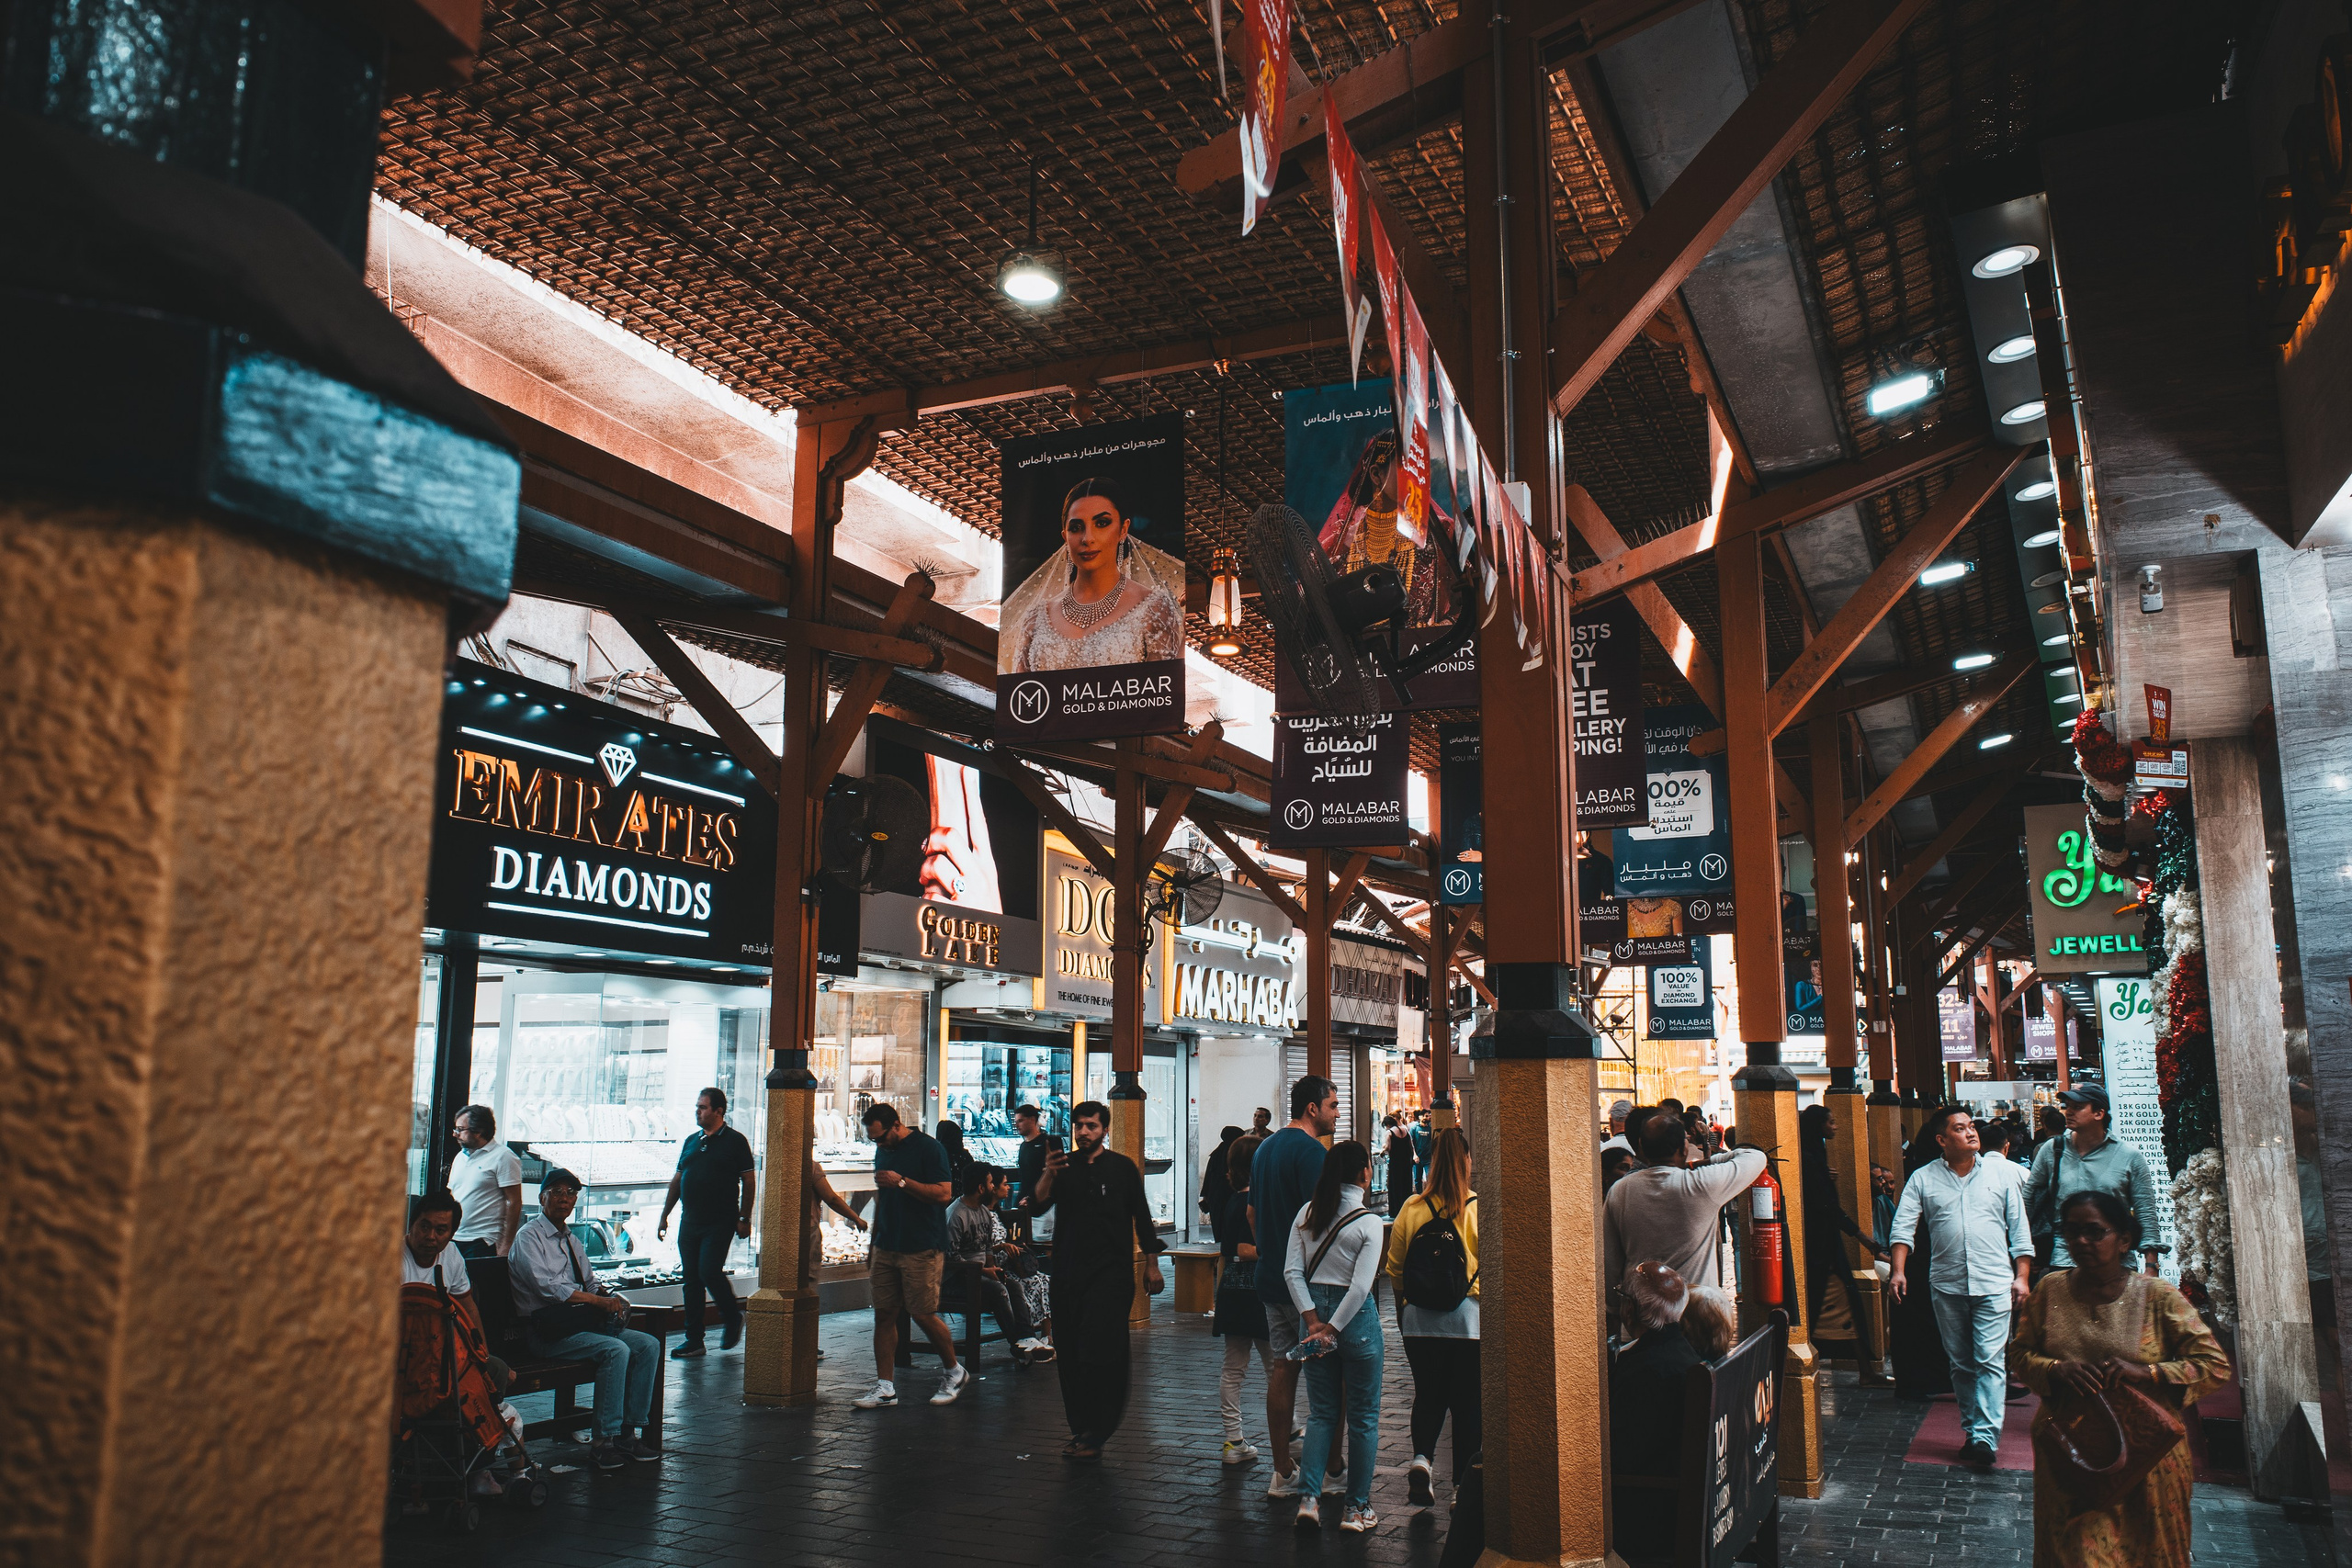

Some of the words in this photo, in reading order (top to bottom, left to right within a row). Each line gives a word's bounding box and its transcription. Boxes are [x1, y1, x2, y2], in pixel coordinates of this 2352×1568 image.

[1303, 410, 1341, 427] وألماس
[1343, 408, 1371, 422] ذهب
[1105, 445, 1119, 455] من
[1121, 437, 1166, 451] مجوهرات
[1018, 451, 1052, 468] وألماس
[1054, 450, 1078, 463] ذهب
[1080, 446, 1103, 459] ملبار
[1063, 676, 1172, 702] MALABAR
[1062, 702, 1096, 715] GOLD
[1098, 702, 1106, 712] &
[1108, 695, 1172, 711] DIAMONDS
[2152, 698, 2165, 711] WIN
[1655, 726, 1685, 739] الوقت
[1304, 734, 1377, 754] المضافة
[1658, 742, 1678, 755] في
[1647, 778, 1702, 799] 00%
[449, 749, 743, 873] EMIRATES
[1322, 801, 1400, 816] MALABAR
[1584, 804, 1636, 815] DIAMONDS
[1322, 816, 1346, 825] GOLD
[1347, 816, 1353, 824] &
[1354, 815, 1400, 824] DIAMONDS
[1620, 860, 1691, 874] ملبار
[487, 844, 712, 920] DIAMONDS
[922, 906, 1001, 945] GOLDEN
[924, 929, 1001, 965] LAKE
[1637, 941, 1685, 951] MALABAR
[2049, 934, 2144, 955] JEWELL
[1661, 973, 1698, 984] 100%
[1058, 991, 1067, 1001] THE
[1068, 993, 1082, 1004] HOME
[1082, 995, 1091, 1004] OF
[1091, 997, 1101, 1007] FINE
[1175, 964, 1299, 1030] MARHABA
[2109, 982, 2154, 1021] Ya
[1668, 1018, 1712, 1026] MALABAR
[1941, 1019, 1961, 1033] 11
[1715, 1414, 1727, 1462] 101
